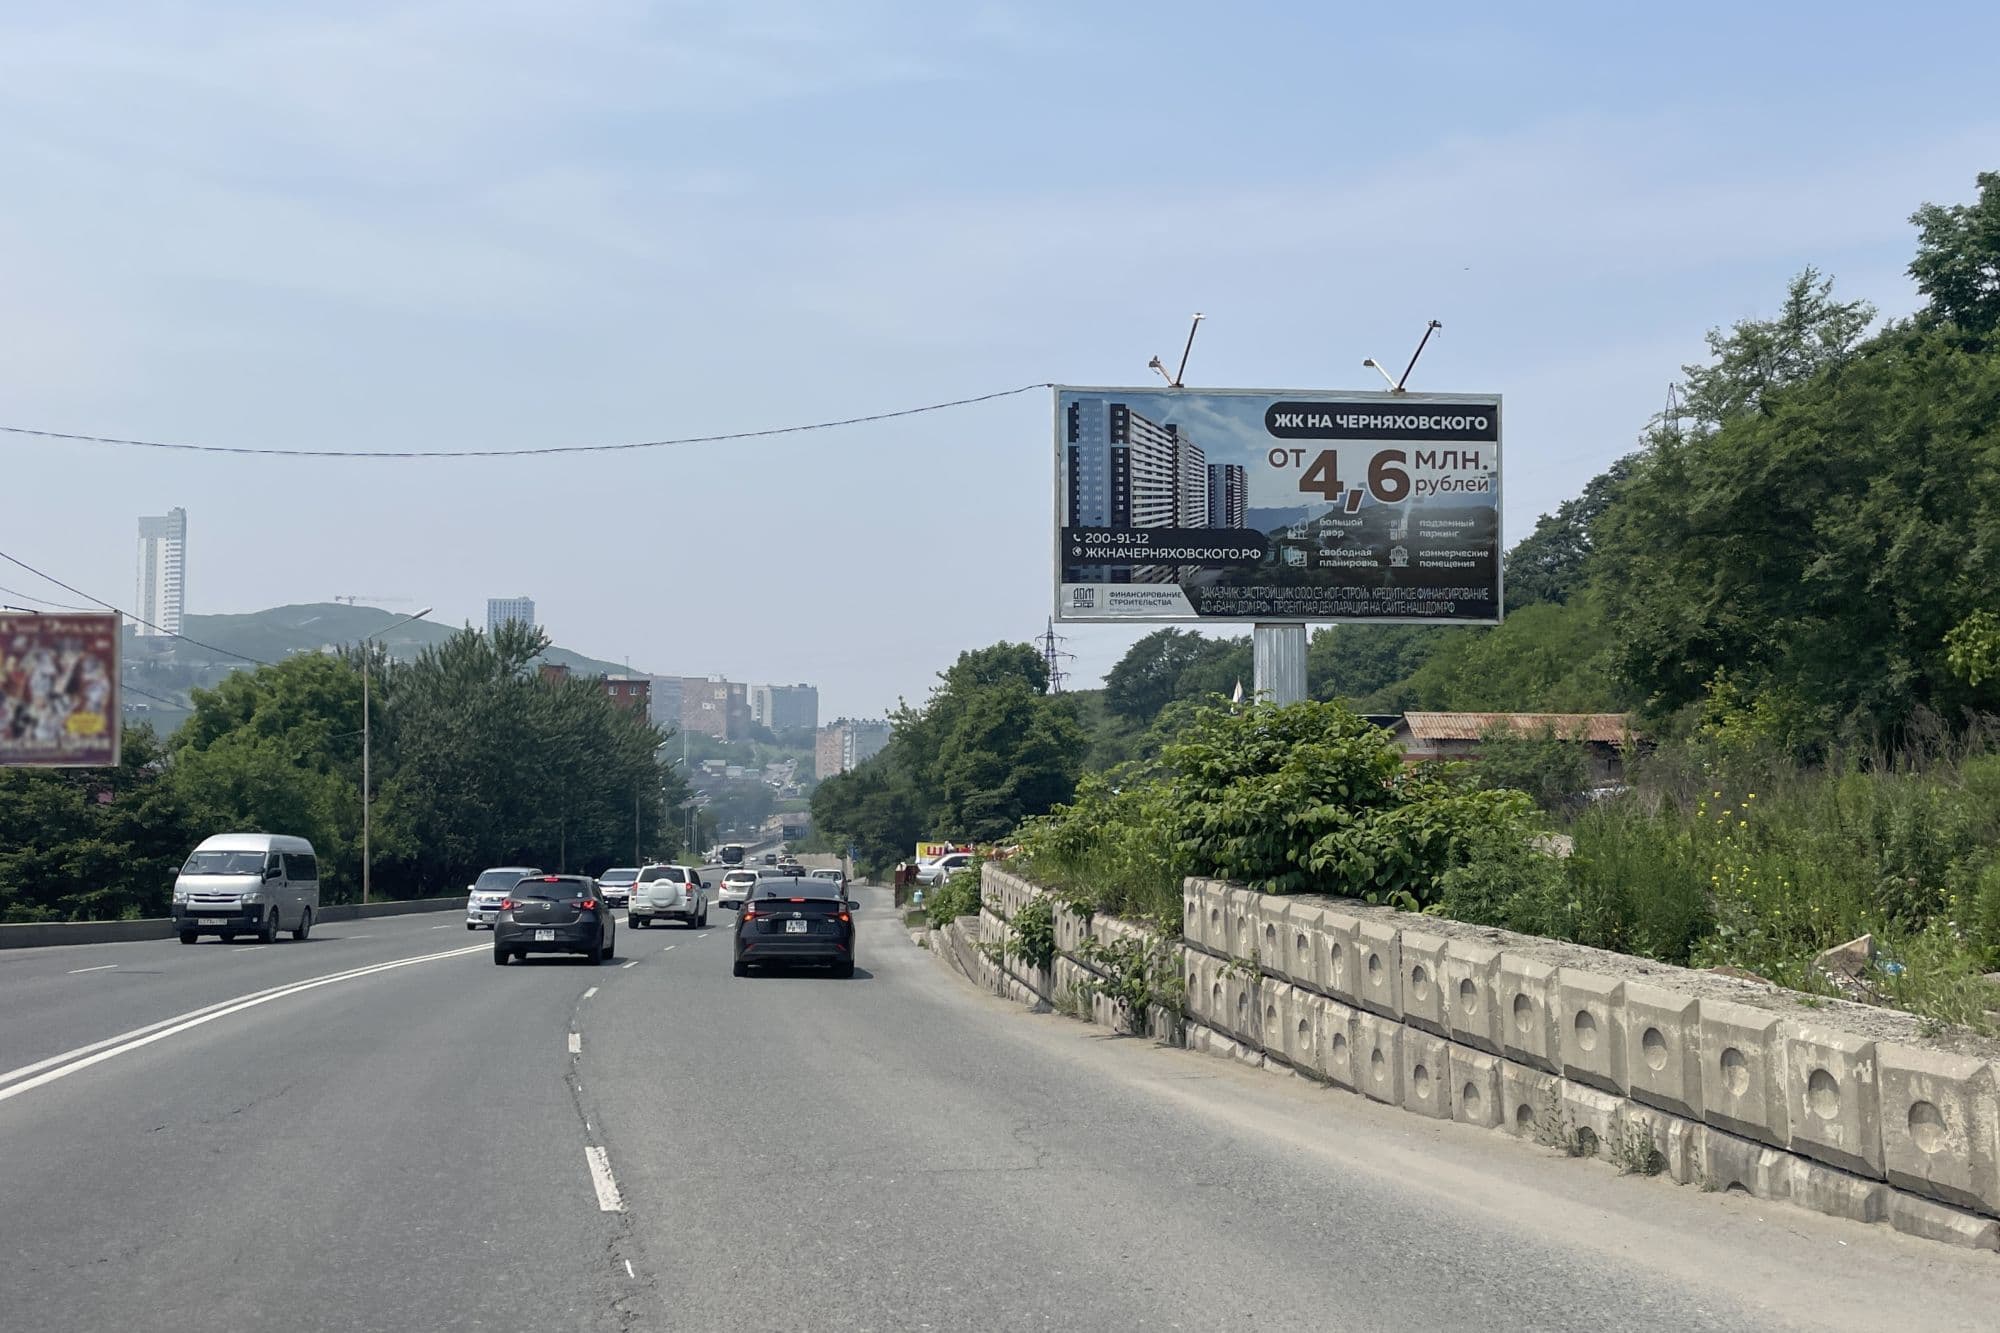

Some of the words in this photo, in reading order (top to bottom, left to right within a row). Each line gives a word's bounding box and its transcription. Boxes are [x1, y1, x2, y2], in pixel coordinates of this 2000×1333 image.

[1274, 413, 1304, 428] ЖК
[1307, 414, 1333, 429] НА
[1336, 415, 1488, 430] ЧЕРНЯХОВСКОГО
[1268, 448, 1306, 468] ОТ
[1299, 449, 1411, 512] 4,6
[1415, 450, 1489, 470] МЛН.
[1415, 475, 1489, 496] рублей
[1319, 518, 1363, 527] большой
[1085, 533, 1149, 544] 200-91-12
[1319, 530, 1344, 538] двор
[1419, 530, 1459, 538] паркинг
[1085, 548, 1261, 560] ЖКНАЧЕРНЯХОВСКОГО.РФ
[1319, 548, 1372, 558] свободная
[1419, 550, 1489, 559] коммерческие
[1319, 559, 1379, 568] планировка
[1419, 560, 1475, 568] помещения
[1109, 591, 1182, 599] ФИНАНСИРОВАНИЕ
[1109, 599, 1173, 607] СТРОИТЕЛЬСТВА
